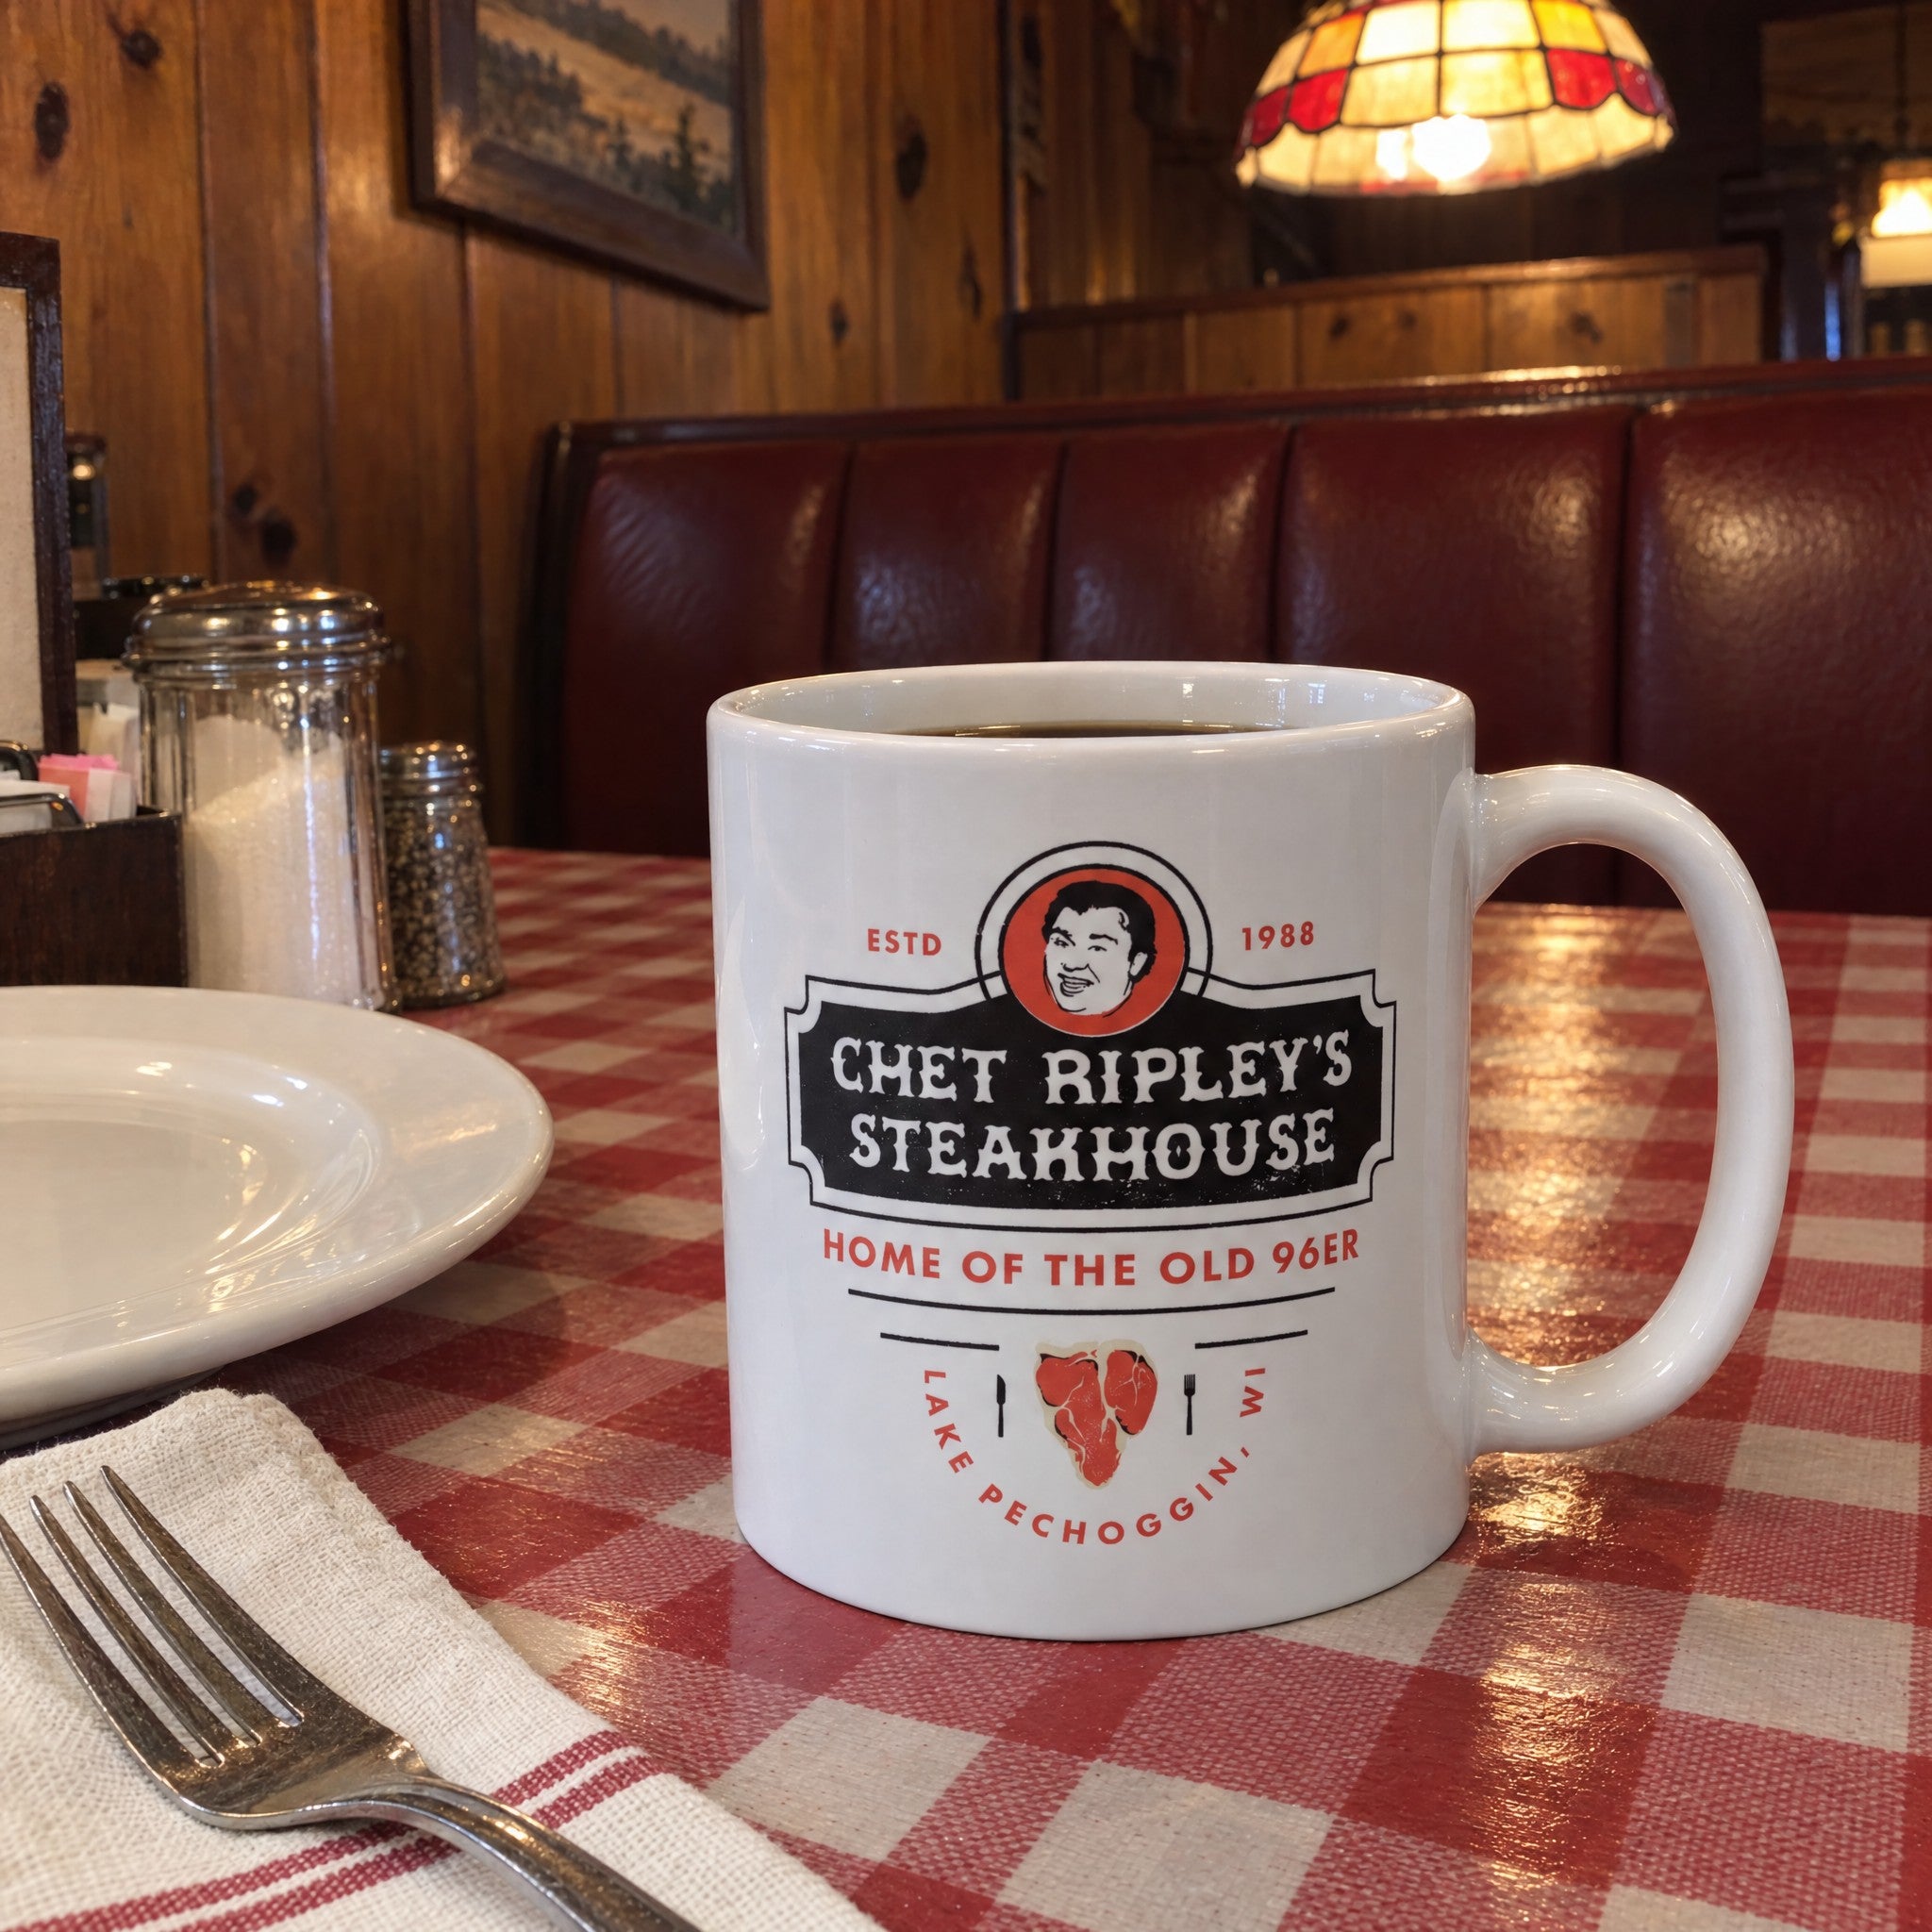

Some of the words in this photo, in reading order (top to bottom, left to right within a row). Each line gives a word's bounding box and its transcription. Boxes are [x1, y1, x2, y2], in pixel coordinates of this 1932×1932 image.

[867, 928, 941, 956] ESTD
[1241, 920, 1314, 952] 1988
[831, 1037, 1008, 1103] CHET
[1041, 1029, 1353, 1106] RIPLEY'S
[849, 1108, 1336, 1182] STEAKHOUSE
[824, 1228, 940, 1279] HOME
[961, 1251, 1024, 1284] OF
[1043, 1254, 1136, 1286] THE
[1159, 1247, 1255, 1285] OLD
[1272, 1228, 1359, 1274] 96ER
[924, 1369, 974, 1474] LAKE
[978, 1446, 1251, 1545] PECHOGGIN,
[1240, 1367, 1266, 1418] WI
